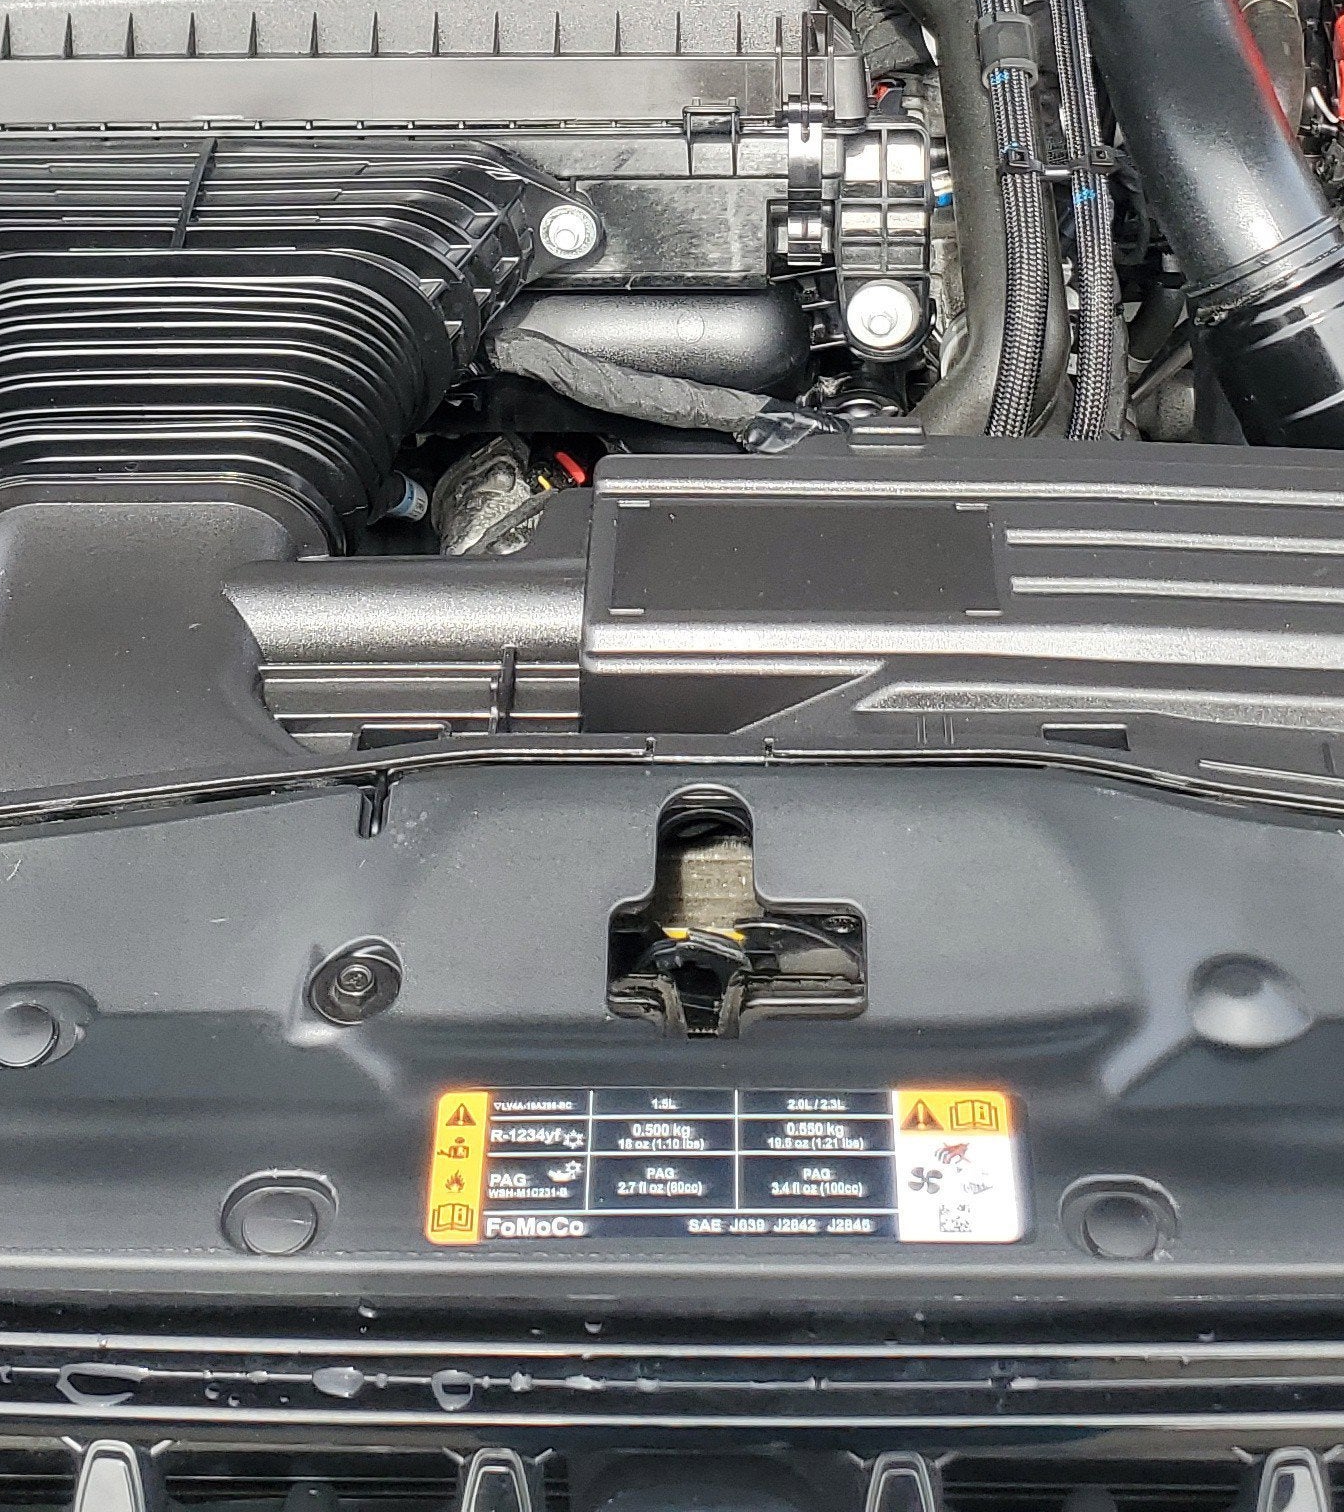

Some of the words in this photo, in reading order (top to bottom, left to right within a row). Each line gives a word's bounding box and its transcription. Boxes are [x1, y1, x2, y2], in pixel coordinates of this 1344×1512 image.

[787, 1098, 813, 1110] 2.0L
[490, 1128, 562, 1144] R-1234yf
[632, 1123, 671, 1136] 0.500
[672, 1123, 691, 1139] kg
[786, 1122, 824, 1135] 0.550
[826, 1122, 845, 1138] kg
[634, 1140, 650, 1149] oz
[682, 1138, 704, 1151] lbs)
[794, 1140, 810, 1149] oz
[811, 1137, 839, 1150] (1.21
[842, 1137, 864, 1150] lbs)
[646, 1167, 676, 1179] PAG
[803, 1168, 831, 1180] PAG
[489, 1174, 527, 1187] PAG
[618, 1181, 635, 1194] 2.7
[650, 1184, 664, 1194] oz
[771, 1182, 789, 1194] 3.4
[802, 1185, 817, 1194] oz
[820, 1182, 863, 1197] (100cc)
[486, 1217, 585, 1237] FoMoCo
[688, 1218, 723, 1232] SAE
